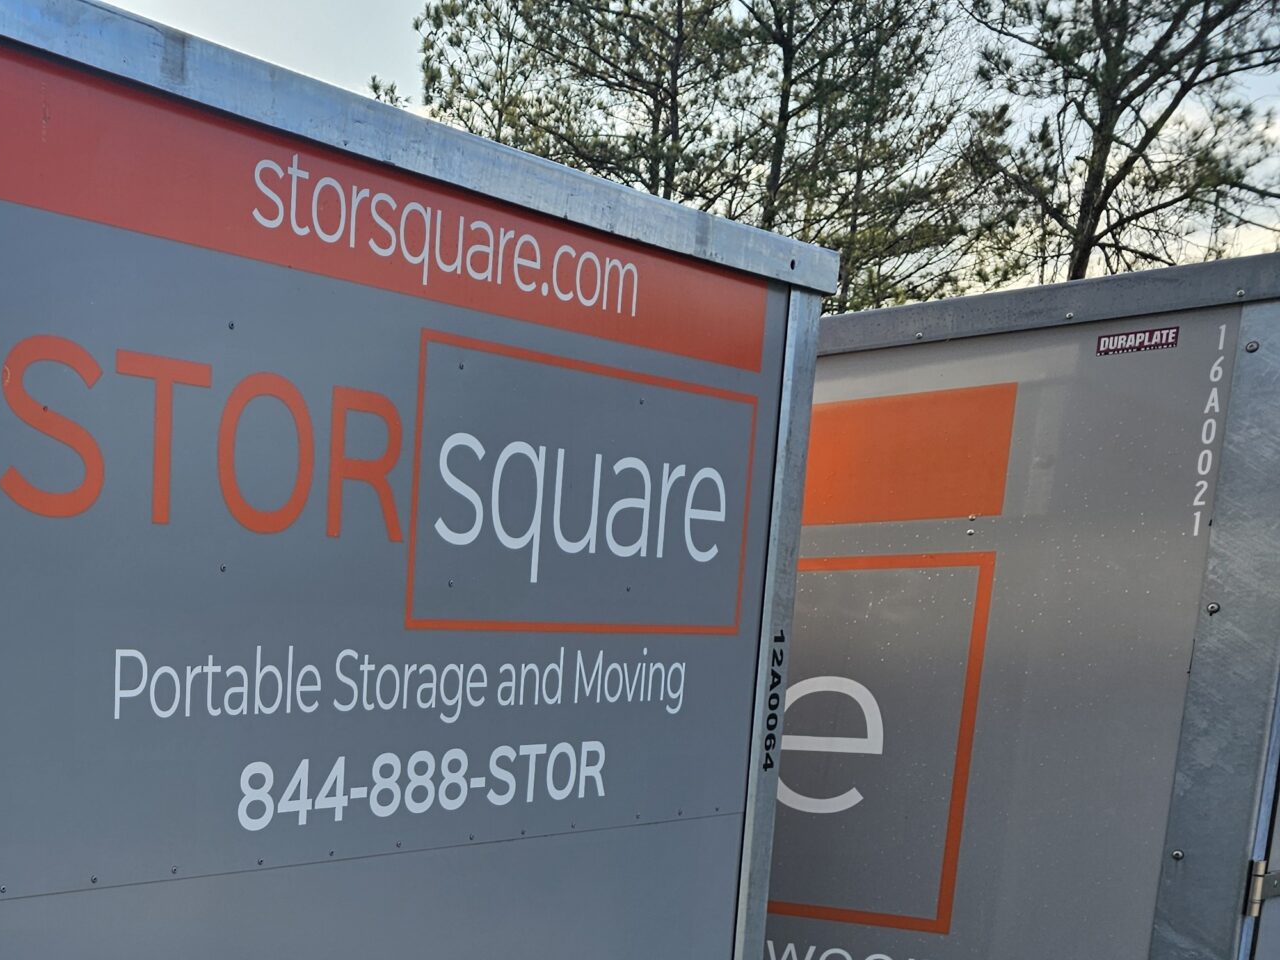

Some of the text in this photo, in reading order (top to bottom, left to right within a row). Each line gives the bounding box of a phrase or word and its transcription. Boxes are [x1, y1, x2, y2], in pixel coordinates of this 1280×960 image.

[252, 153, 639, 317] storsquare.com
[1099, 328, 1178, 351] DURAPLATE
[1192, 323, 1227, 537] 16A0021
[433, 431, 727, 583] square
[113, 645, 686, 724] Portable Storage and Moving
[762, 629, 786, 772] 12A0064
[237, 740, 607, 831] 844-888-STOR
